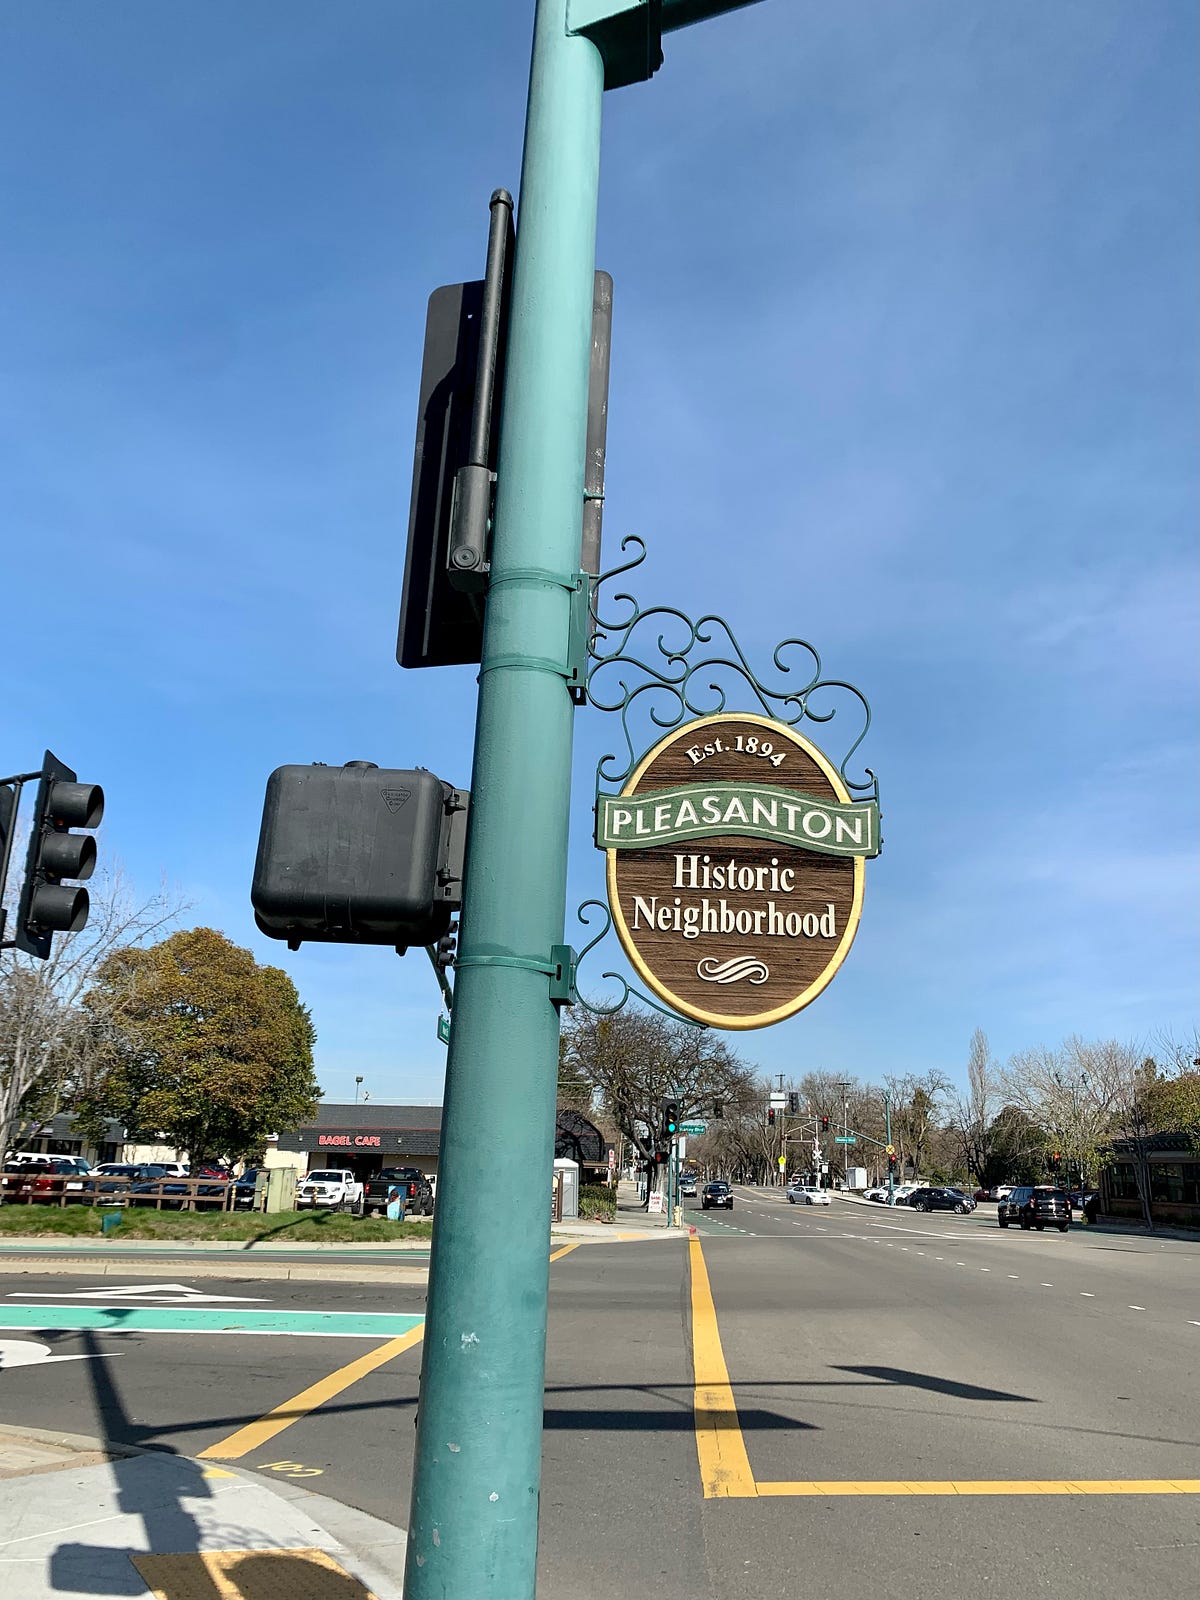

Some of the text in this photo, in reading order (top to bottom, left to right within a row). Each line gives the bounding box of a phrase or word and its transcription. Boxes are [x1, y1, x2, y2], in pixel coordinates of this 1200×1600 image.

[685, 735, 787, 767] Est. 1894
[612, 796, 863, 844] PLEASANTON
[672, 854, 795, 892] Historic
[631, 896, 838, 938] Neighborhood
[318, 1135, 381, 1147] BAGEL CAFE
